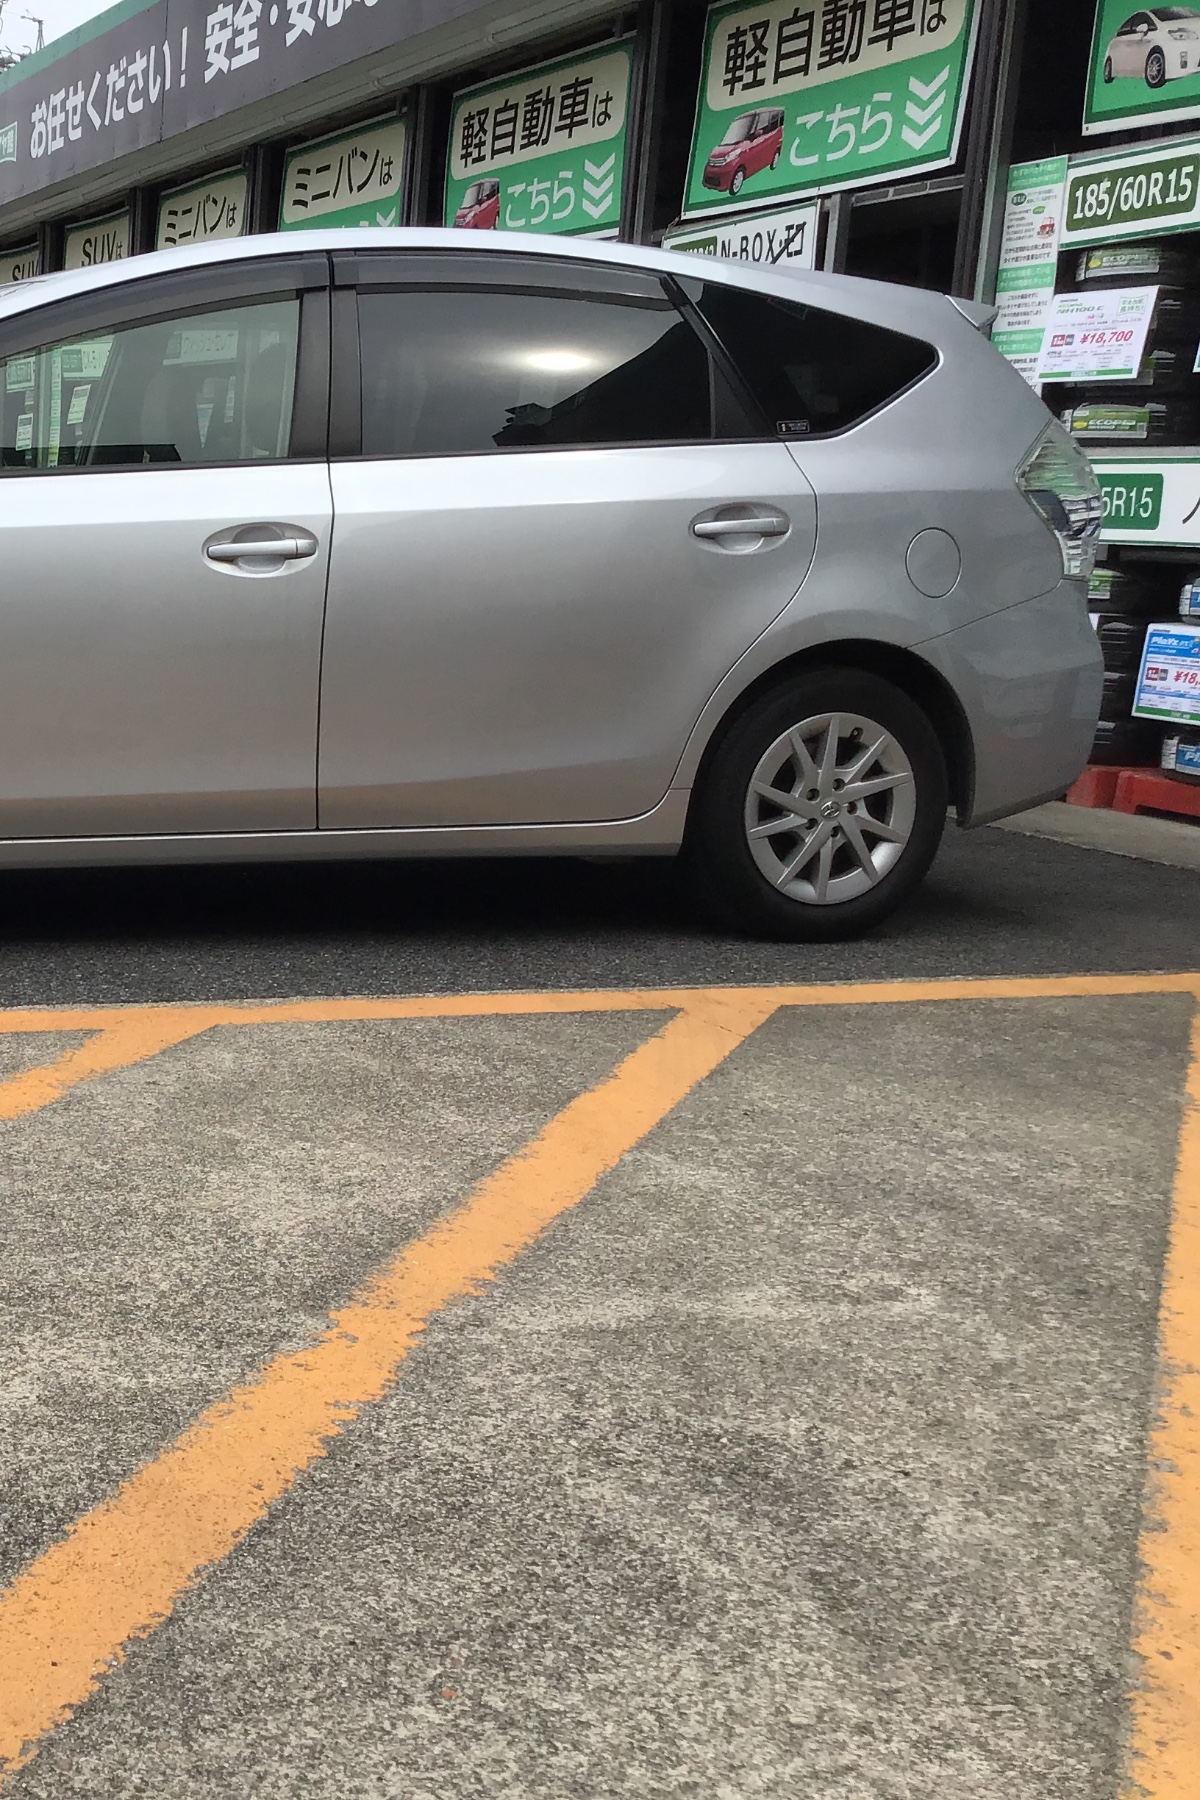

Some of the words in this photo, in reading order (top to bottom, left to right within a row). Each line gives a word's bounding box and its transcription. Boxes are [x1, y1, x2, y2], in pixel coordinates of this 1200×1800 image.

[722, 0, 947, 96] 軽自動車は
[30, 26, 188, 158] お任せください！
[460, 77, 613, 168] 軽自動車は
[789, 92, 893, 167] こちら
[292, 146, 394, 209] ミニバンは
[505, 171, 576, 228] こちら
[1072, 165, 1195, 221] 185/60R15
[164, 193, 237, 245] ミニバンは
[81, 230, 123, 267] SUVは
[1079, 330, 1134, 346] ¥18,700
[1173, 670, 1200, 687] ¥18,
